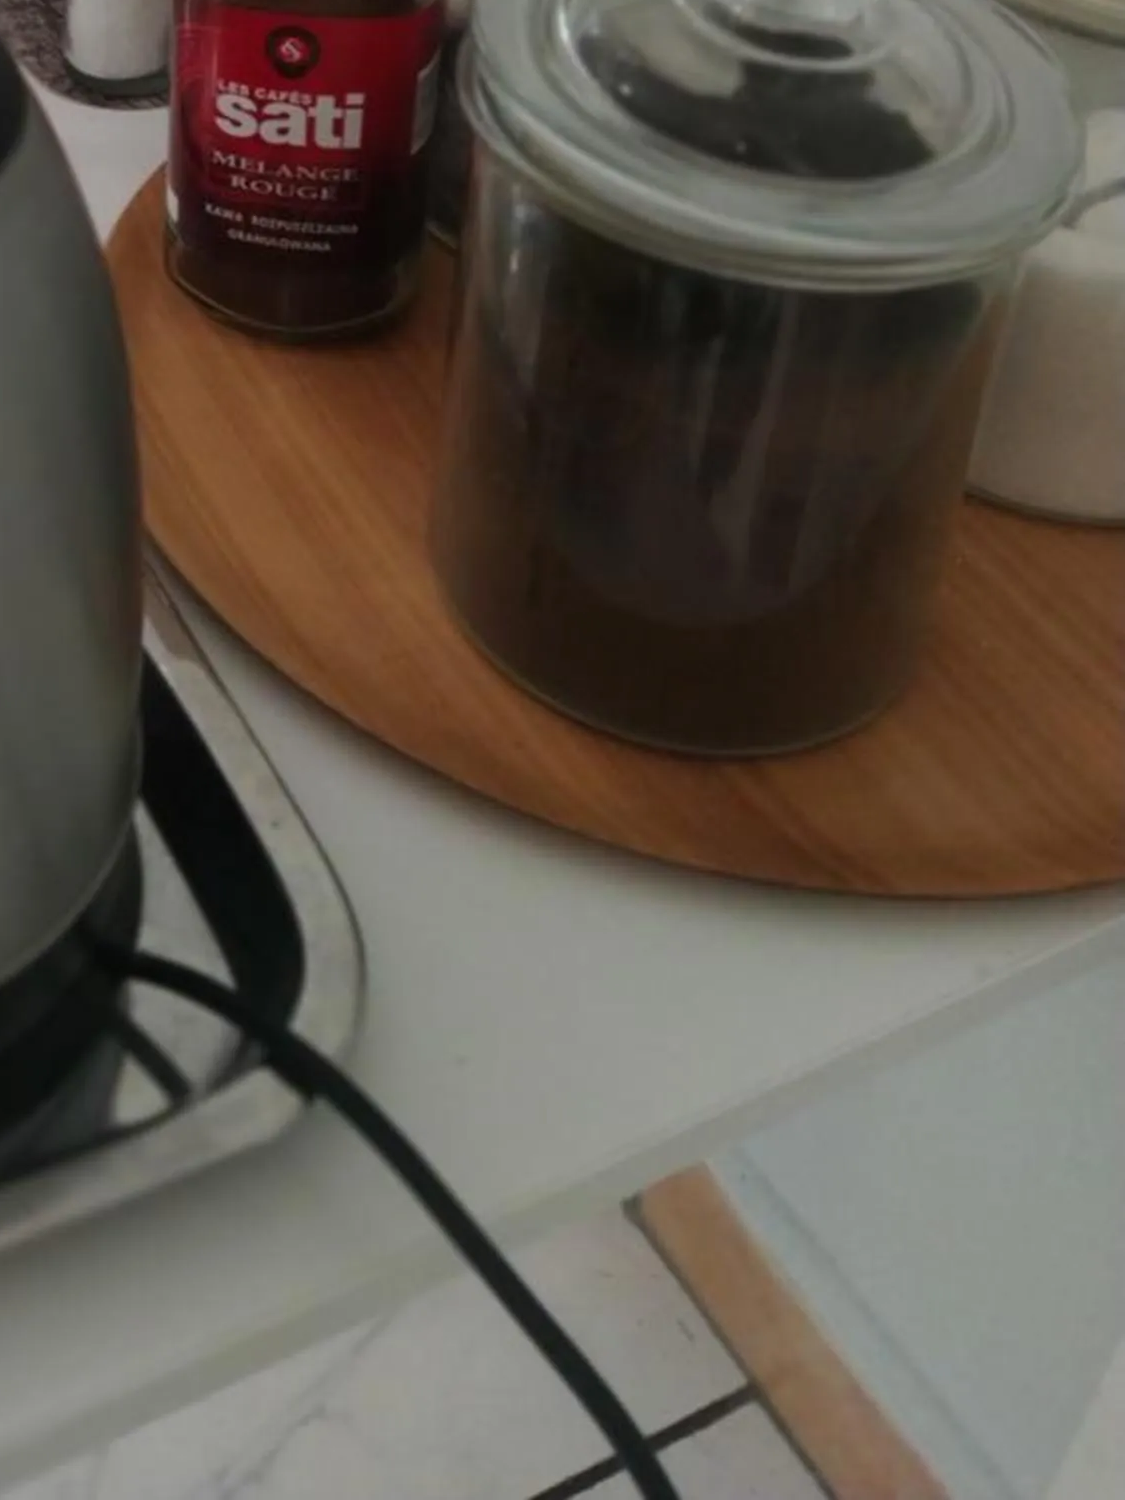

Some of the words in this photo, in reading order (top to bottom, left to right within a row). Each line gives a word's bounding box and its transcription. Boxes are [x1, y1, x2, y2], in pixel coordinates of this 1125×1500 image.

[217, 79, 250, 96] LES
[214, 92, 366, 150] sati
[211, 150, 359, 183] MELANGE
[229, 173, 338, 202] ROUGE
[204, 202, 244, 223] KAWA
